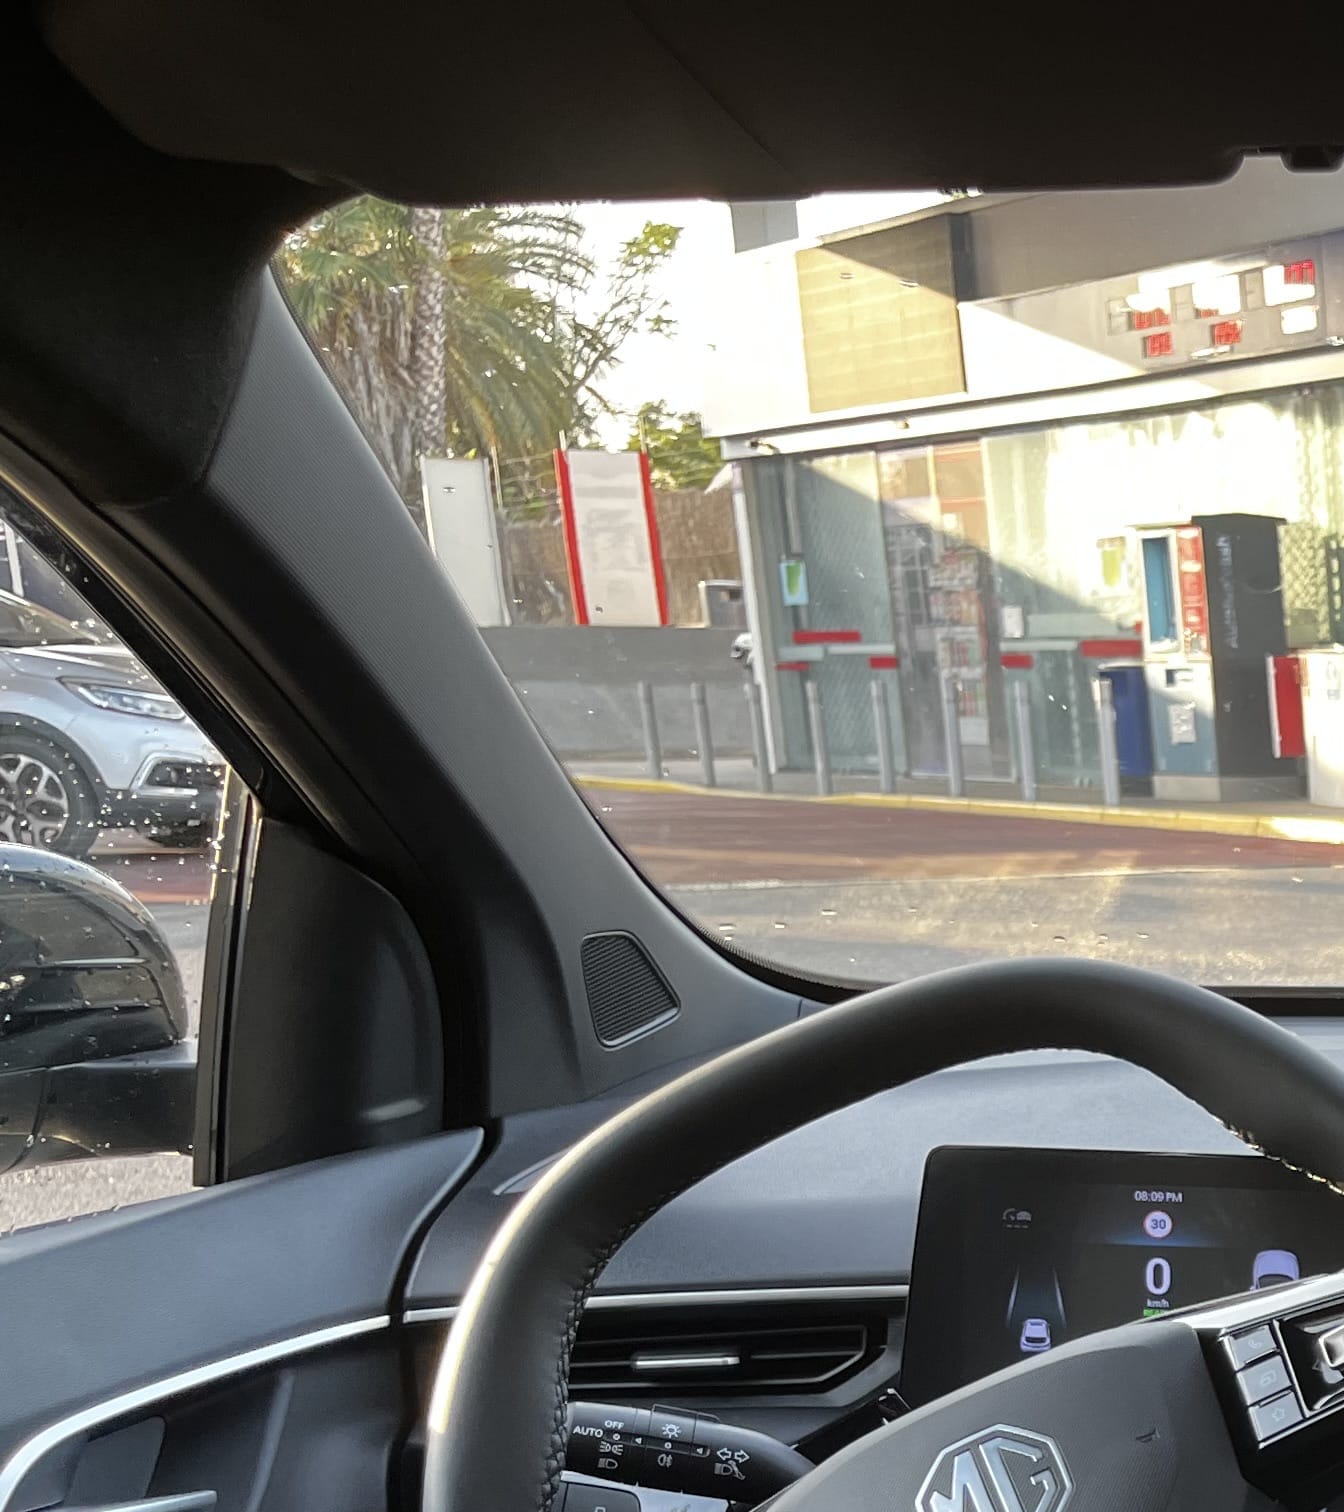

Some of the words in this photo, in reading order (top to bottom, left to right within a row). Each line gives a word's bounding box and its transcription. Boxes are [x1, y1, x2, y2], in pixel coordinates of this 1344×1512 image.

[1134, 1190, 1165, 1202] 08:09
[1165, 1191, 1183, 1203] PM
[1150, 1218, 1167, 1230] 30
[1145, 1257, 1171, 1296] 0
[1146, 1298, 1170, 1309] km/h
[604, 1419, 625, 1431] OFF
[572, 1424, 604, 1439] AUTO
